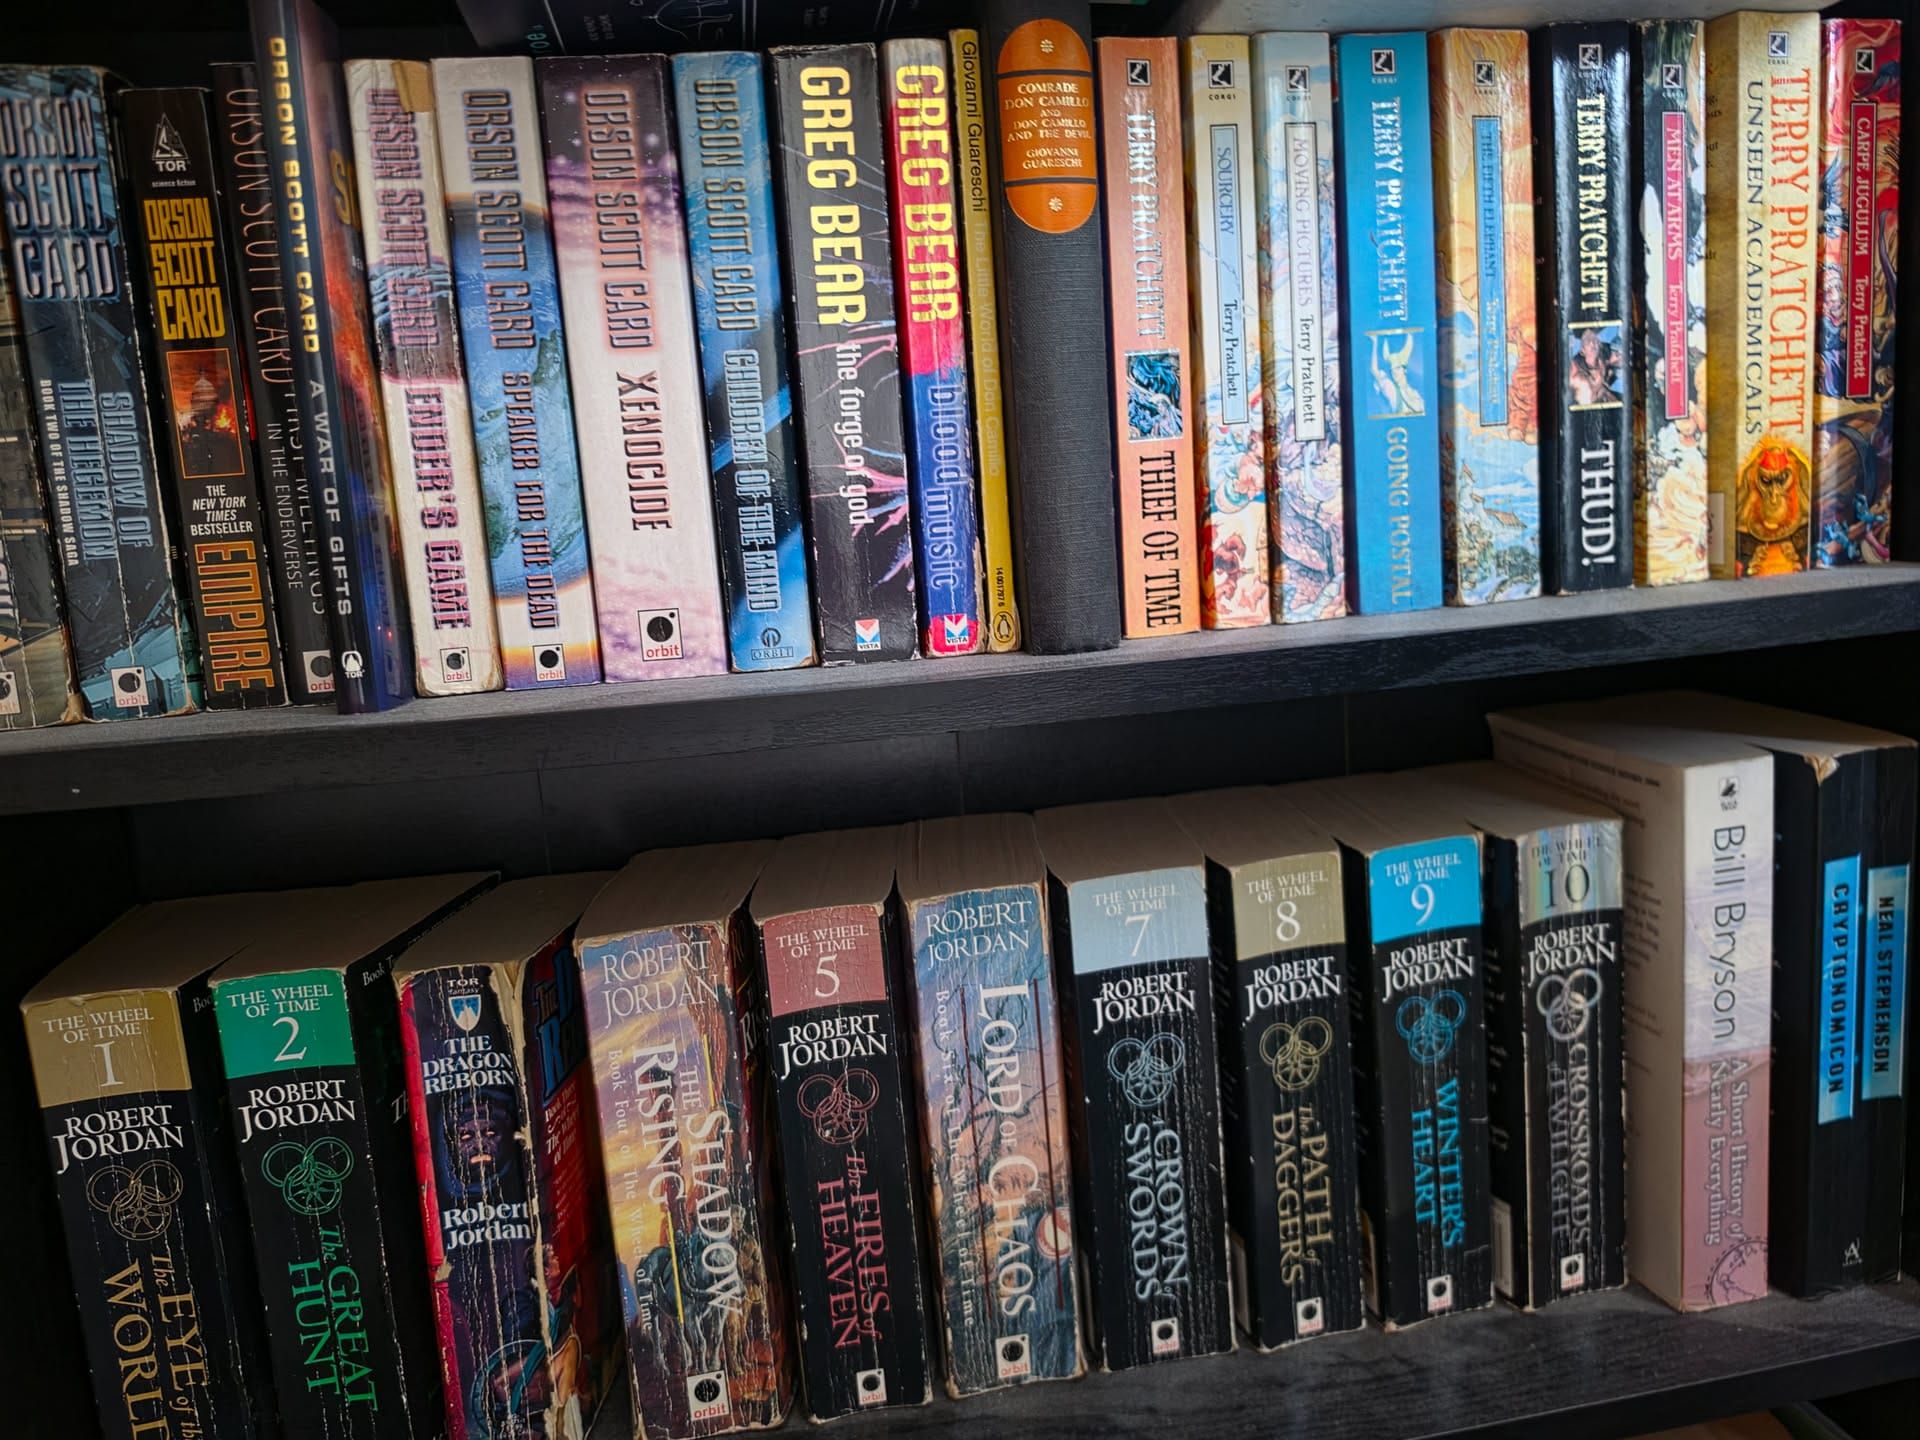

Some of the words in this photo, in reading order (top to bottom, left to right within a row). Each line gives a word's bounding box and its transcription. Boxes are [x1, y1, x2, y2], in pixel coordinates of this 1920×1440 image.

[269, 37, 297, 146] ORSON
[961, 41, 982, 118] Giovanni
[1005, 98, 1034, 110] DON
[1039, 95, 1089, 108] CAMILLO
[1017, 83, 1079, 95] COMRADE
[1208, 93, 1237, 101] CORGI
[0, 97, 97, 158] ORSON
[800, 66, 857, 189] GREG
[895, 65, 950, 187] GREG
[1040, 109, 1061, 118] AND
[1576, 93, 1606, 174] TERRY
[1770, 68, 1811, 193] TERRY
[155, 160, 187, 172] TOR
[1022, 158, 1083, 169] GUARESCHI
[1026, 147, 1079, 159] GIOVANNI
[1746, 81, 1764, 205] UNSEEN
[1856, 117, 1871, 169] CARPE
[967, 122, 988, 213] Guareschi
[1217, 146, 1234, 236] SOURCERY
[3, 163, 104, 230] SCOTT
[144, 198, 213, 241] ORSON
[284, 160, 309, 258] SCOTT
[1855, 176, 1870, 257] JUGULUM
[150, 240, 217, 286] SCOTT
[810, 205, 867, 325] BEAR
[904, 203, 959, 323] BEAR
[1578, 175, 1609, 312] PRATCHETT
[15, 237, 119, 300] CARD
[157, 287, 226, 340] CARD
[296, 271, 321, 353] CARD
[1222, 299, 1238, 335] Terry
[1855, 276, 1869, 313] Terry
[1745, 217, 1764, 435] ACADEMICALS
[1769, 204, 1809, 434] PRATCHETT
[836, 343, 862, 381] the
[1222, 335, 1241, 399] Pratchett
[1853, 315, 1868, 380] Pratchett
[40, 379, 52, 412] BOOK
[58, 381, 96, 428] THE
[309, 380, 325, 398] A
[46, 415, 56, 440] TWO
[267, 423, 283, 438] IN
[502, 371, 541, 471] SPEAKER
[834, 386, 865, 449] forge
[928, 386, 966, 487] blood
[50, 443, 61, 460] OF
[100, 391, 148, 509] SHADOW
[269, 447, 288, 478] THE
[313, 412, 335, 474] WAR
[616, 370, 672, 531] XENOCIDE
[1387, 427, 1409, 506] GOING
[53, 463, 65, 482] THE
[206, 485, 226, 497] THE
[845, 455, 865, 482] of
[1139, 450, 1177, 523] THIEF
[57, 485, 74, 534] SHADOW
[66, 435, 119, 560] HEGEMON
[192, 498, 216, 510] NEW
[218, 496, 247, 509] YORK
[205, 509, 237, 522] TIMES
[323, 487, 341, 523] OF
[514, 479, 547, 521] FOR
[839, 484, 875, 525] god
[1580, 439, 1616, 566] THUD!
[64, 537, 78, 566] SAGA
[117, 516, 153, 548] OF
[190, 521, 253, 536] BESTSELLER
[275, 485, 303, 589] ENDERVERSE
[521, 528, 553, 568] THE
[925, 489, 961, 590] music
[1142, 530, 1179, 563] OF
[330, 536, 353, 616] GIFTS
[1389, 514, 1412, 604] POSTAL
[194, 540, 275, 692] EMPIRE
[525, 575, 560, 629] DEAD
[1144, 568, 1181, 629] TIME
[646, 645, 681, 658] orbit
[751, 647, 794, 660] ORBIT
[858, 642, 880, 650] VISTA
[1385, 862, 1410, 877] THE
[1414, 853, 1462, 869] WHEEL
[1395, 873, 1412, 887] OF
[1417, 867, 1449, 882] TIME
[1713, 825, 1746, 889] Bill
[926, 901, 1032, 936] ROBERT
[1410, 883, 1435, 926] 9
[1877, 896, 1896, 943] NEAL
[928, 930, 1030, 970] JORDAN
[1534, 923, 1610, 955] ROBERT
[448, 977, 479, 989] TOR
[602, 941, 711, 985] ROBERT
[1527, 941, 1616, 987] JORDAN
[1709, 901, 1746, 1040] Bryson
[227, 992, 268, 1007] THE
[270, 984, 333, 1000] WHEEL
[245, 1003, 271, 1018] OF
[275, 997, 320, 1012] TIME
[604, 975, 720, 1029] JORDAN
[1829, 882, 1849, 1093] CRYPTONOMICON
[1872, 948, 1893, 1073] STEPHENSON
[43, 1017, 86, 1033] THE
[89, 1007, 154, 1027] WHEEL
[63, 1028, 89, 1045] OF
[94, 1022, 141, 1039] TIME
[272, 1017, 307, 1063] 2
[789, 1015, 880, 1044] ROBERT
[423, 1053, 514, 1078] DRAGON
[444, 1035, 492, 1054] THE
[778, 1033, 888, 1080] JORDAN
[979, 979, 1031, 1114] LORD
[1730, 1058, 1750, 1076] A
[424, 1070, 517, 1095] REBORN
[608, 1050, 627, 1090] Book
[679, 1064, 701, 1112] THE
[614, 1100, 629, 1137] Four
[1705, 1060, 1728, 1130] Nearly
[1731, 1082, 1749, 1137] Short
[64, 1105, 173, 1139] ROBERT
[632, 1039, 686, 1205] RISING
[999, 1121, 1018, 1148] OF
[1569, 1042, 1592, 1246] CROSSROADS
[52, 1126, 185, 1175] JORDAN
[846, 1152, 869, 1188] The
[1412, 1108, 1437, 1226] HEART
[623, 1170, 637, 1199] The
[1272, 1111, 1305, 1287] DAGGERS
[1301, 1132, 1335, 1245] PATH
[1704, 1136, 1727, 1246] Everything
[1727, 1143, 1748, 1217] History
[443, 1201, 528, 1229] Robert
[683, 1110, 744, 1318] SHADOW
[1124, 1123, 1162, 1301] SWORDS
[1153, 1129, 1190, 1288] CROWN
[1727, 1222, 1746, 1241] of
[318, 1225, 343, 1262] The
[447, 1221, 532, 1250] Jordan
[626, 1206, 646, 1260] Wheel
[851, 1190, 891, 1313] FIRES
[988, 1155, 1039, 1317] CHAOS
[151, 1253, 176, 1287] The
[636, 1268, 650, 1289] of
[817, 1177, 861, 1349] HEAVEN
[288, 1257, 341, 1395] HUNT
[639, 1293, 655, 1335] Time
[860, 1317, 883, 1341] of
[157, 1292, 208, 1391] EYE
[327, 1264, 378, 1412] GREAT
[169, 1395, 198, 1416] of
[693, 1405, 726, 1419] orbit
